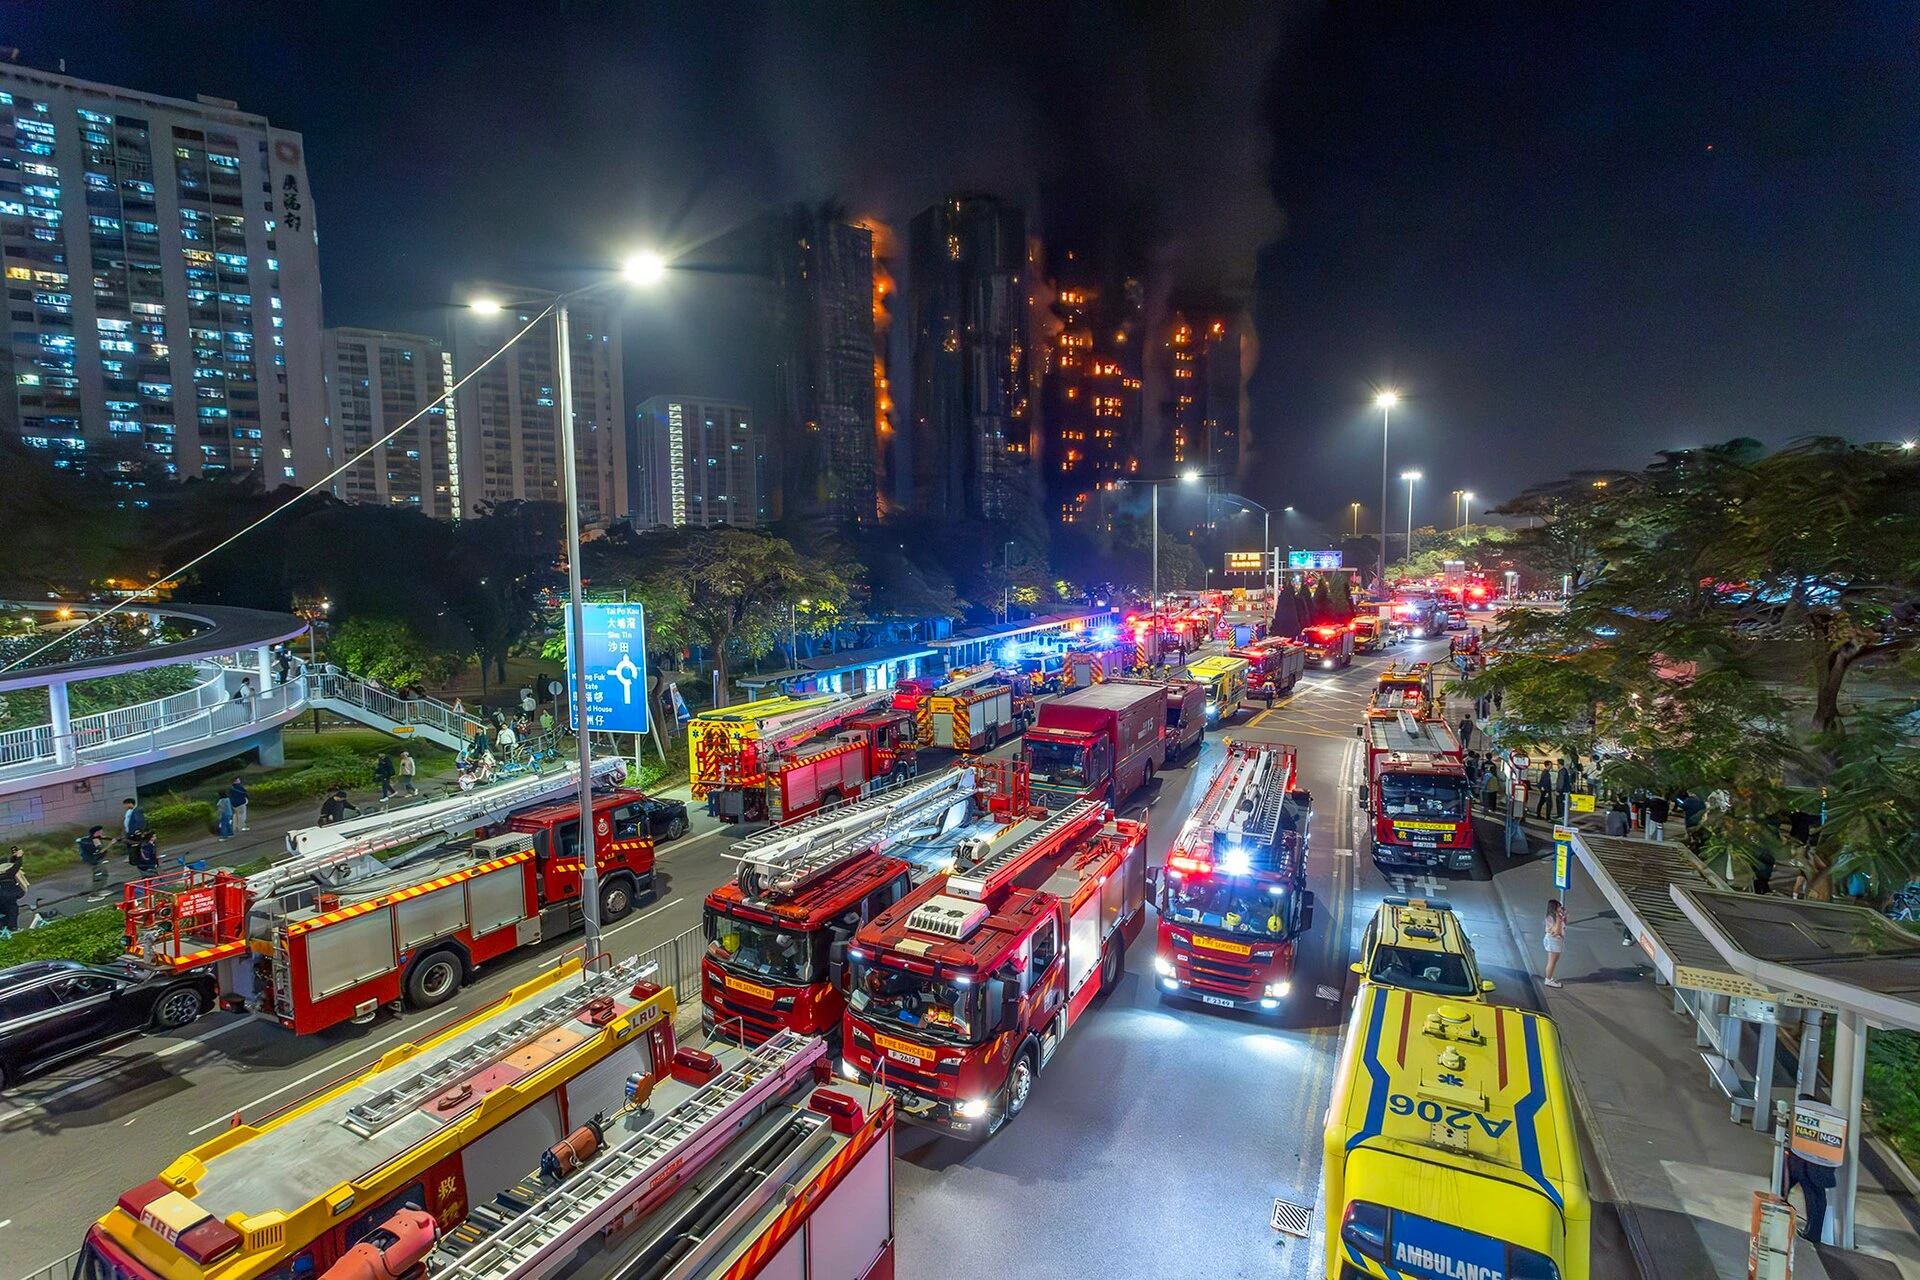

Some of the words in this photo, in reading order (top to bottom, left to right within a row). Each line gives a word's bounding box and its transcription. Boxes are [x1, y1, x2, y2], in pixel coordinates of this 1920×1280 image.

[607, 631, 620, 639] Sha
[608, 641, 629, 653] 沙田
[571, 672, 593, 682] Kng
[593, 673, 606, 681] Fuk
[593, 705, 613, 713] House
[1201, 938, 1214, 946] FIRE
[1214, 941, 1241, 952] SERVICES
[732, 980, 743, 988] FIRE
[742, 983, 766, 996] SERVICES
[632, 1005, 656, 1029] LRU
[884, 1038, 897, 1048] FIRE
[897, 1041, 925, 1057] SERVICES
[900, 1053, 916, 1065] 2612
[1389, 1094, 1513, 1139] A206
[1796, 1126, 1817, 1138] NA47
[1820, 1132, 1841, 1145] N42A
[142, 1210, 178, 1243] FIRE
